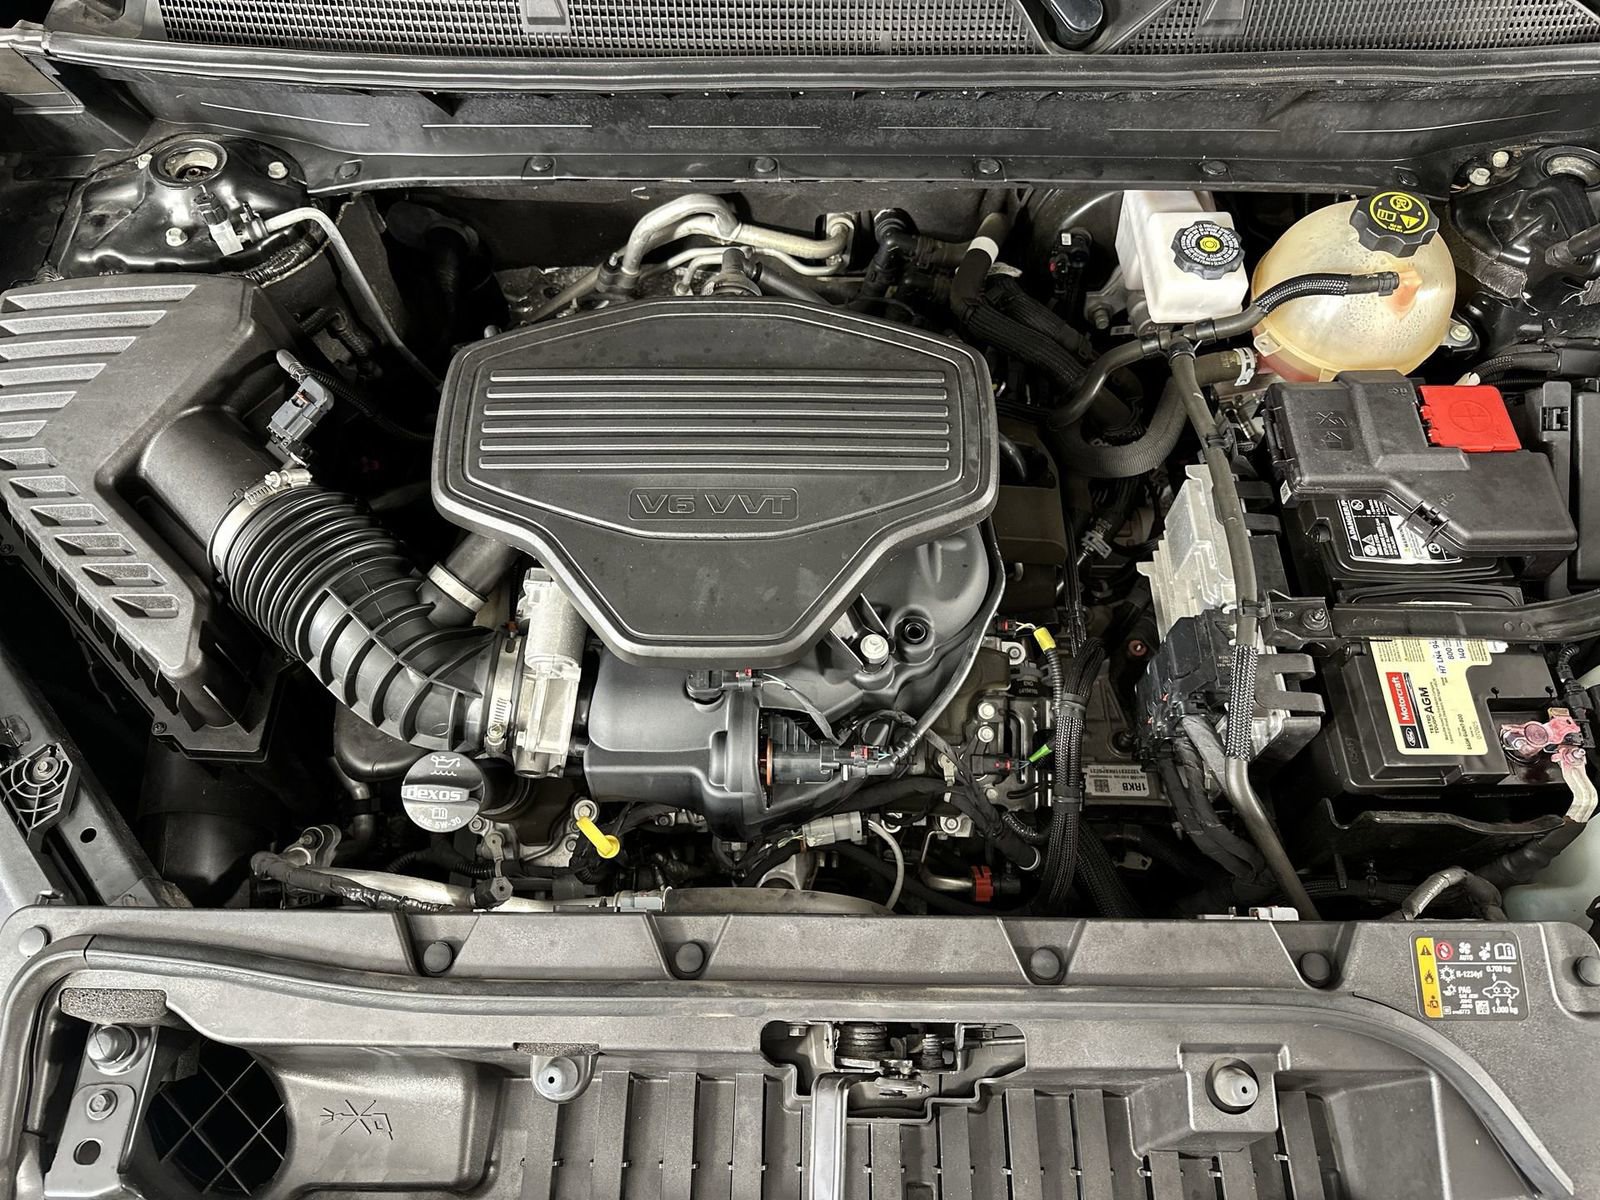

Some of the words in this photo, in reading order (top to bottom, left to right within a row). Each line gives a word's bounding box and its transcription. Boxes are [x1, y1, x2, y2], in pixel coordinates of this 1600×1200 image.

[636, 493, 695, 514] V6
[704, 493, 792, 514] VVT
[1445, 647, 1455, 660] 800
[1457, 647, 1466, 659] 140
[1439, 665, 1447, 674] H7
[1391, 676, 1411, 721] Motorcraft
[1418, 687, 1435, 714] AGM
[1122, 782, 1146, 791] 1RKB
[406, 786, 464, 801] dexos
[1455, 970, 1483, 979] R-1234yf
[1457, 986, 1471, 994] PAG
